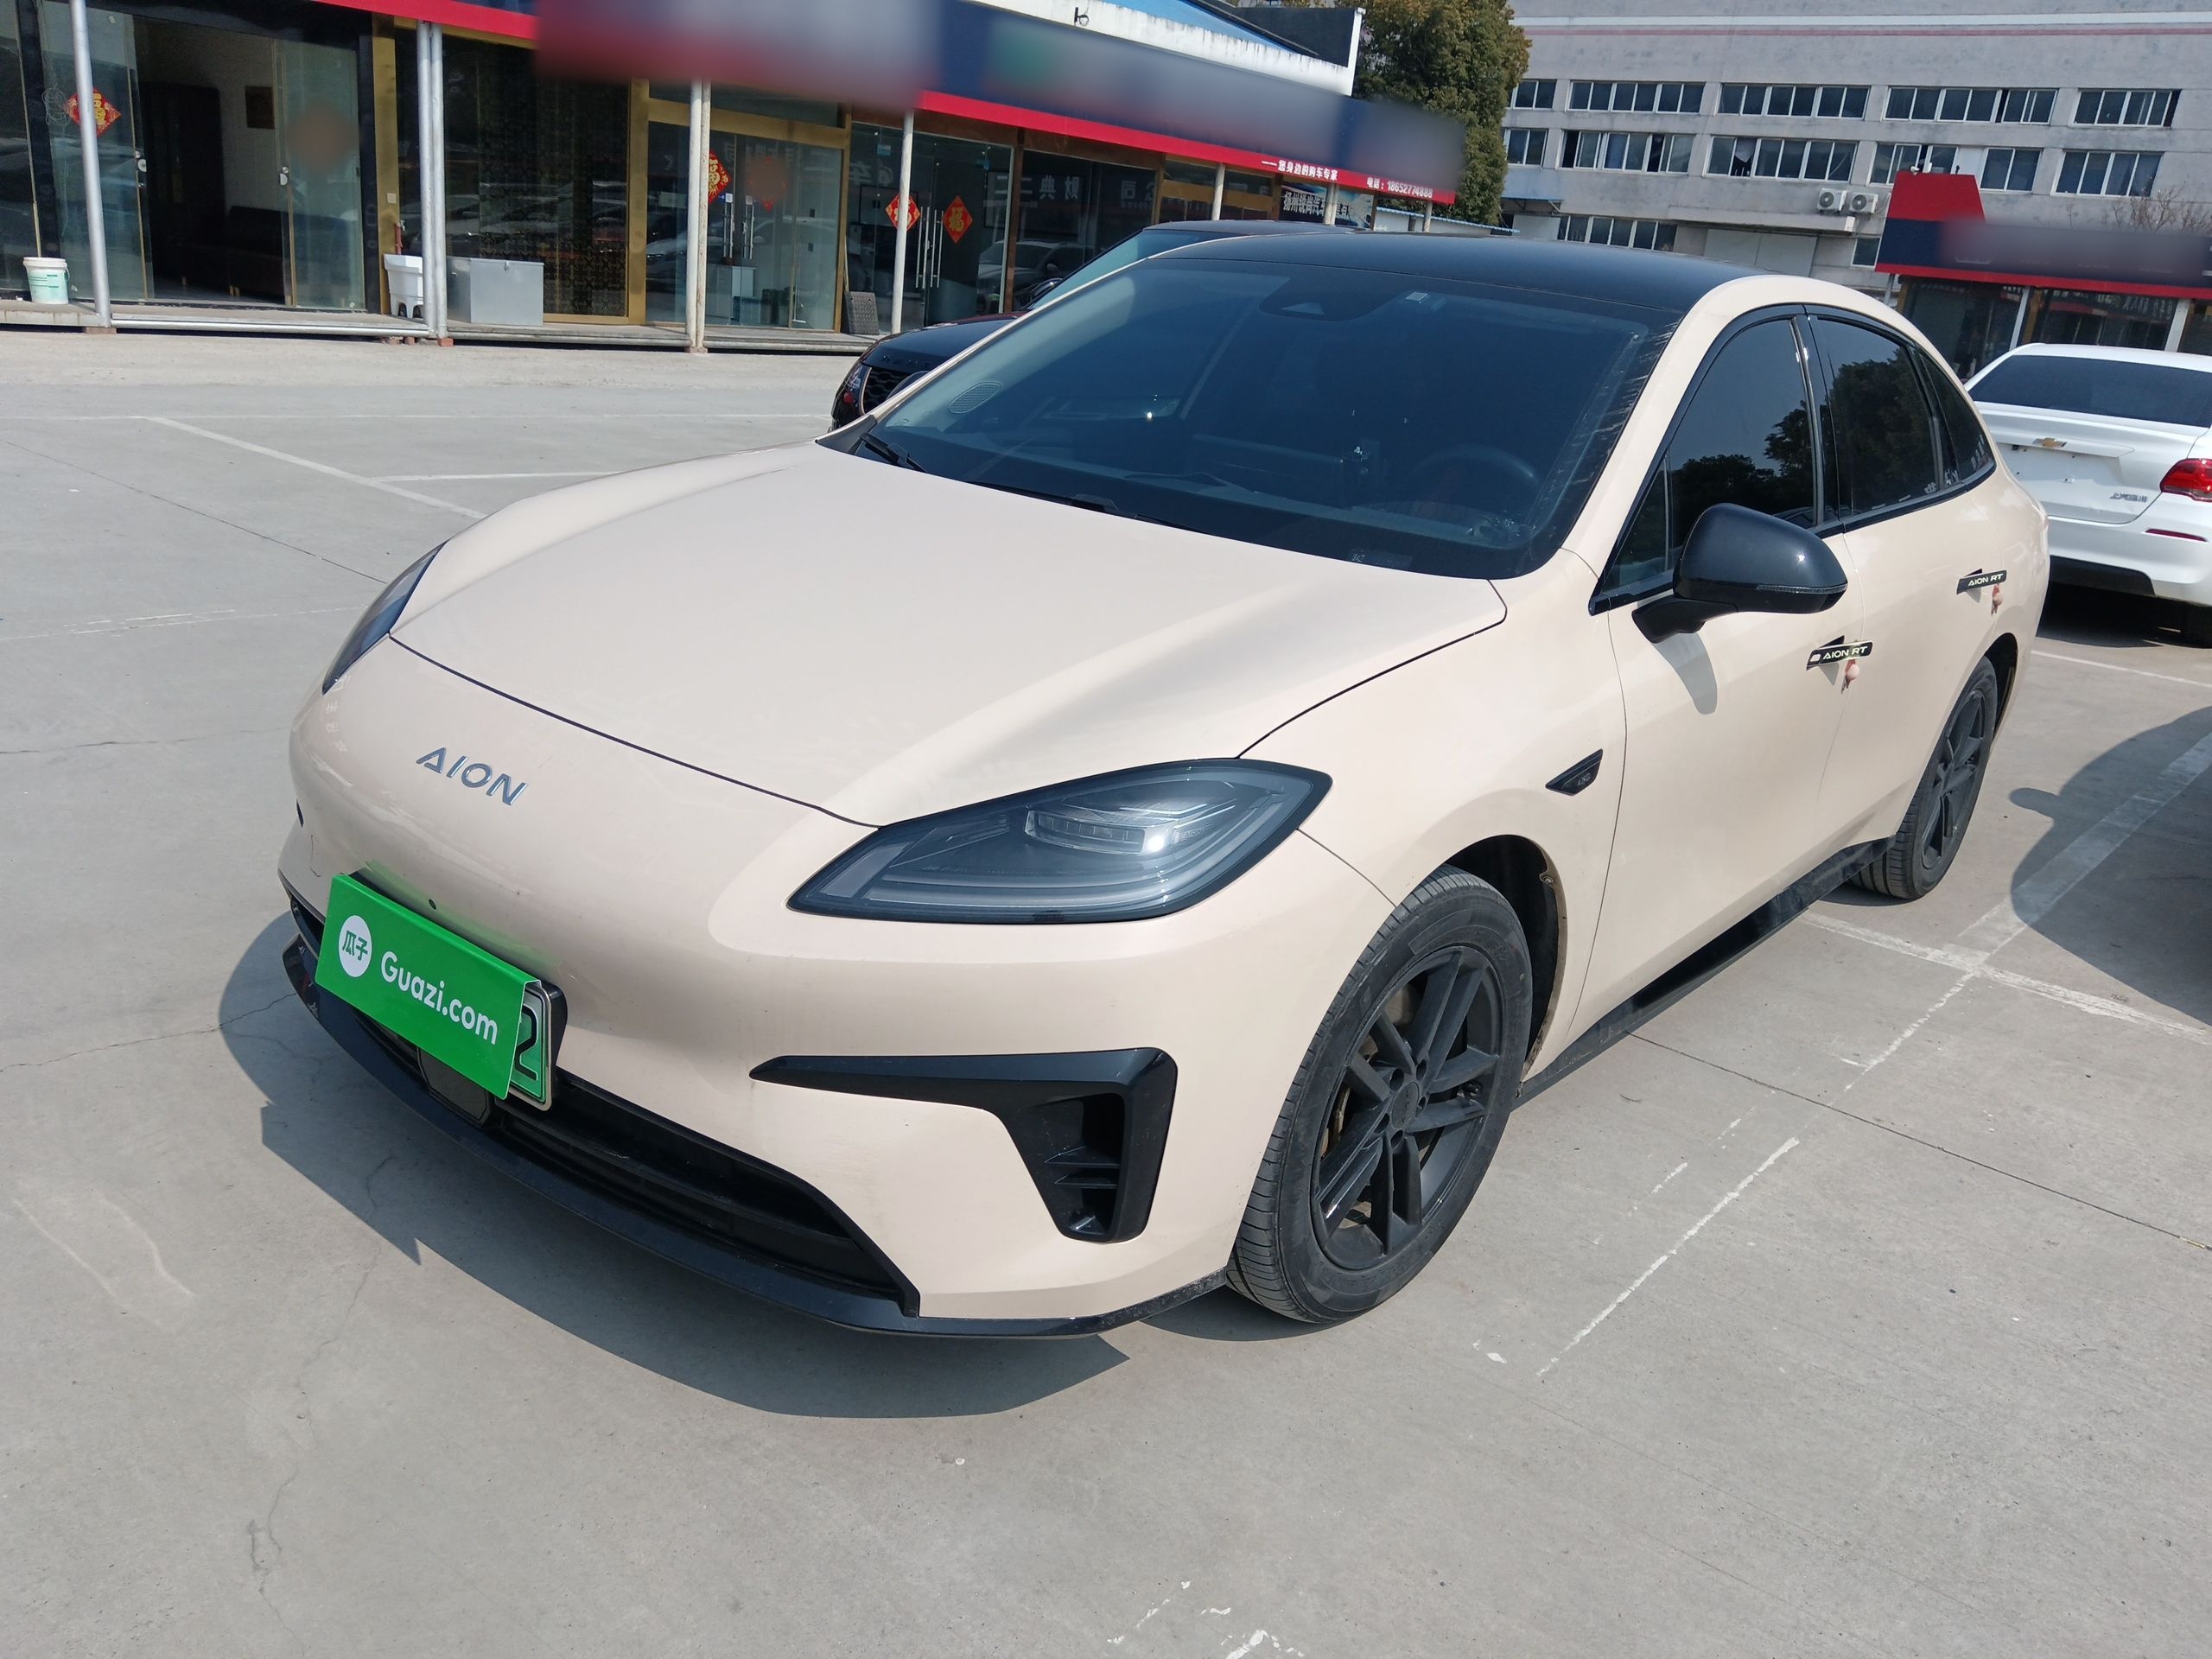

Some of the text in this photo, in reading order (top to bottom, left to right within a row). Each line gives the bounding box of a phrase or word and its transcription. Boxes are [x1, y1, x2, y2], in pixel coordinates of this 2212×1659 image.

[1968, 576, 1988, 586] AION
[1823, 646, 1867, 660] AION RT
[416, 747, 528, 805] AION
[342, 931, 368, 961] 瓜子
[381, 951, 499, 1045] Guazi.com
